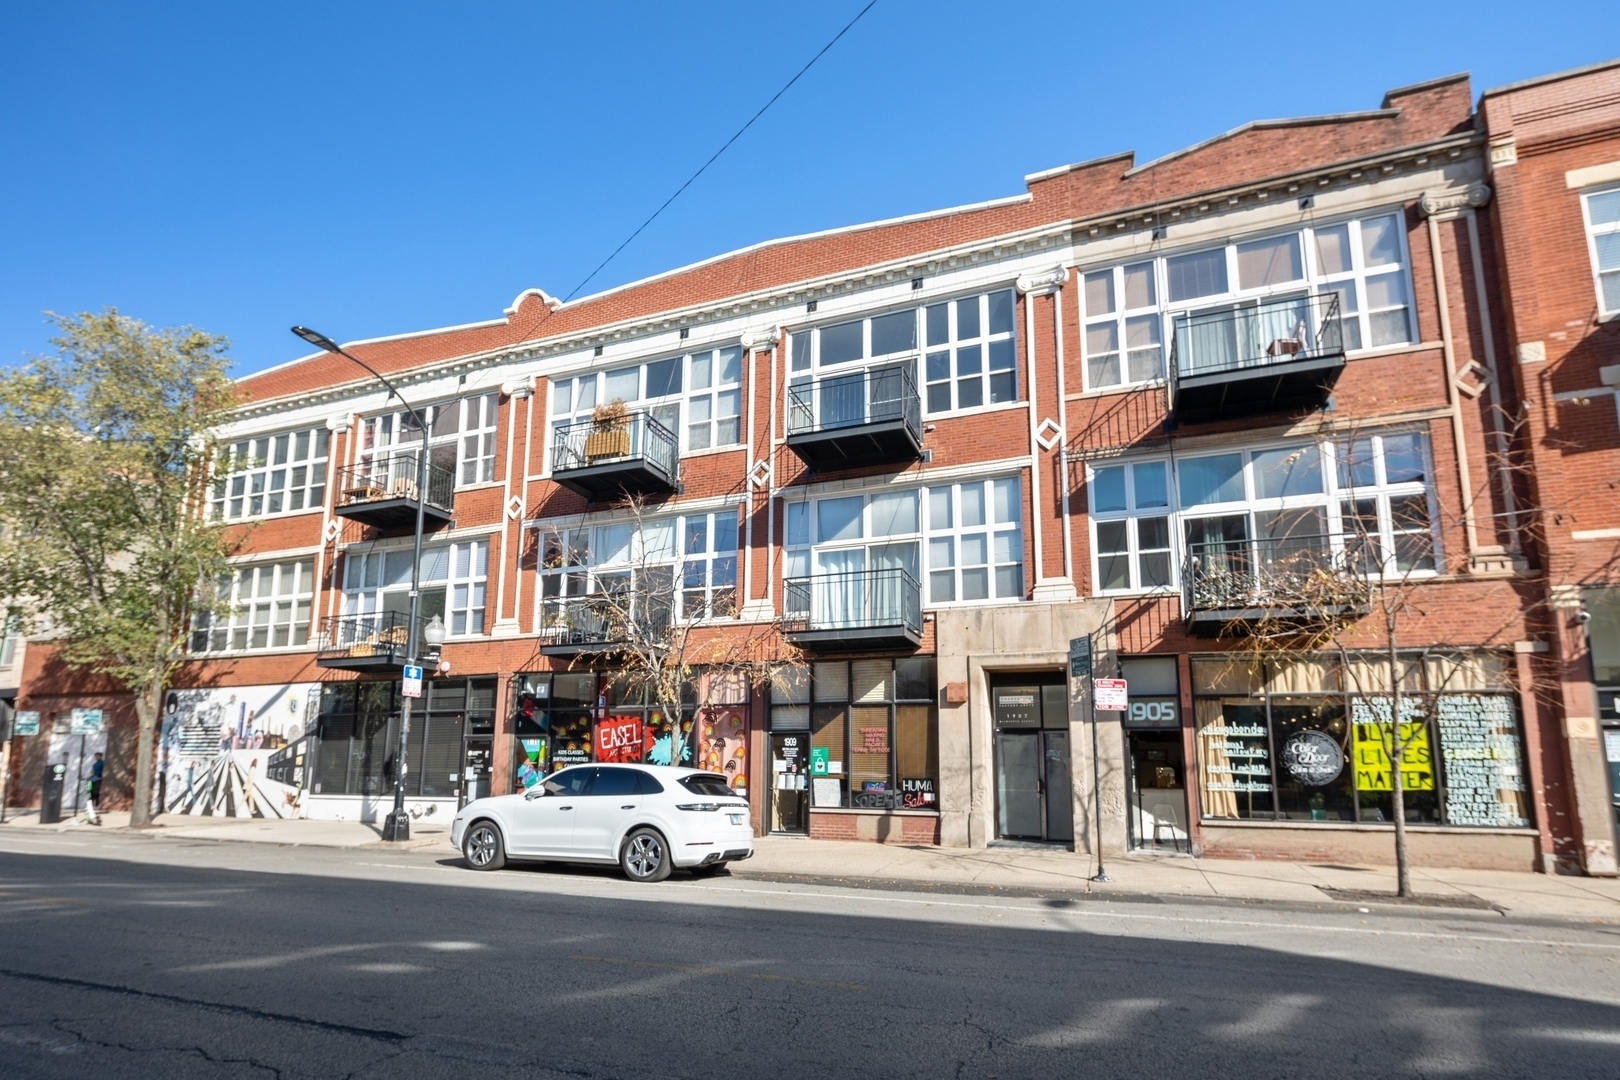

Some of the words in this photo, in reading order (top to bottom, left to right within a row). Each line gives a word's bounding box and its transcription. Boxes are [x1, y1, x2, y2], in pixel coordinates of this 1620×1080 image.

[1128, 702, 1175, 720] 1905
[600, 723, 642, 749] EASEL
[1358, 725, 1423, 742] BLACK
[783, 737, 797, 746] 1909
[1361, 747, 1431, 764] LIES
[1443, 749, 1491, 759] GEORGE
[903, 780, 933, 791] HUMA
[860, 794, 893, 807] OPEN
